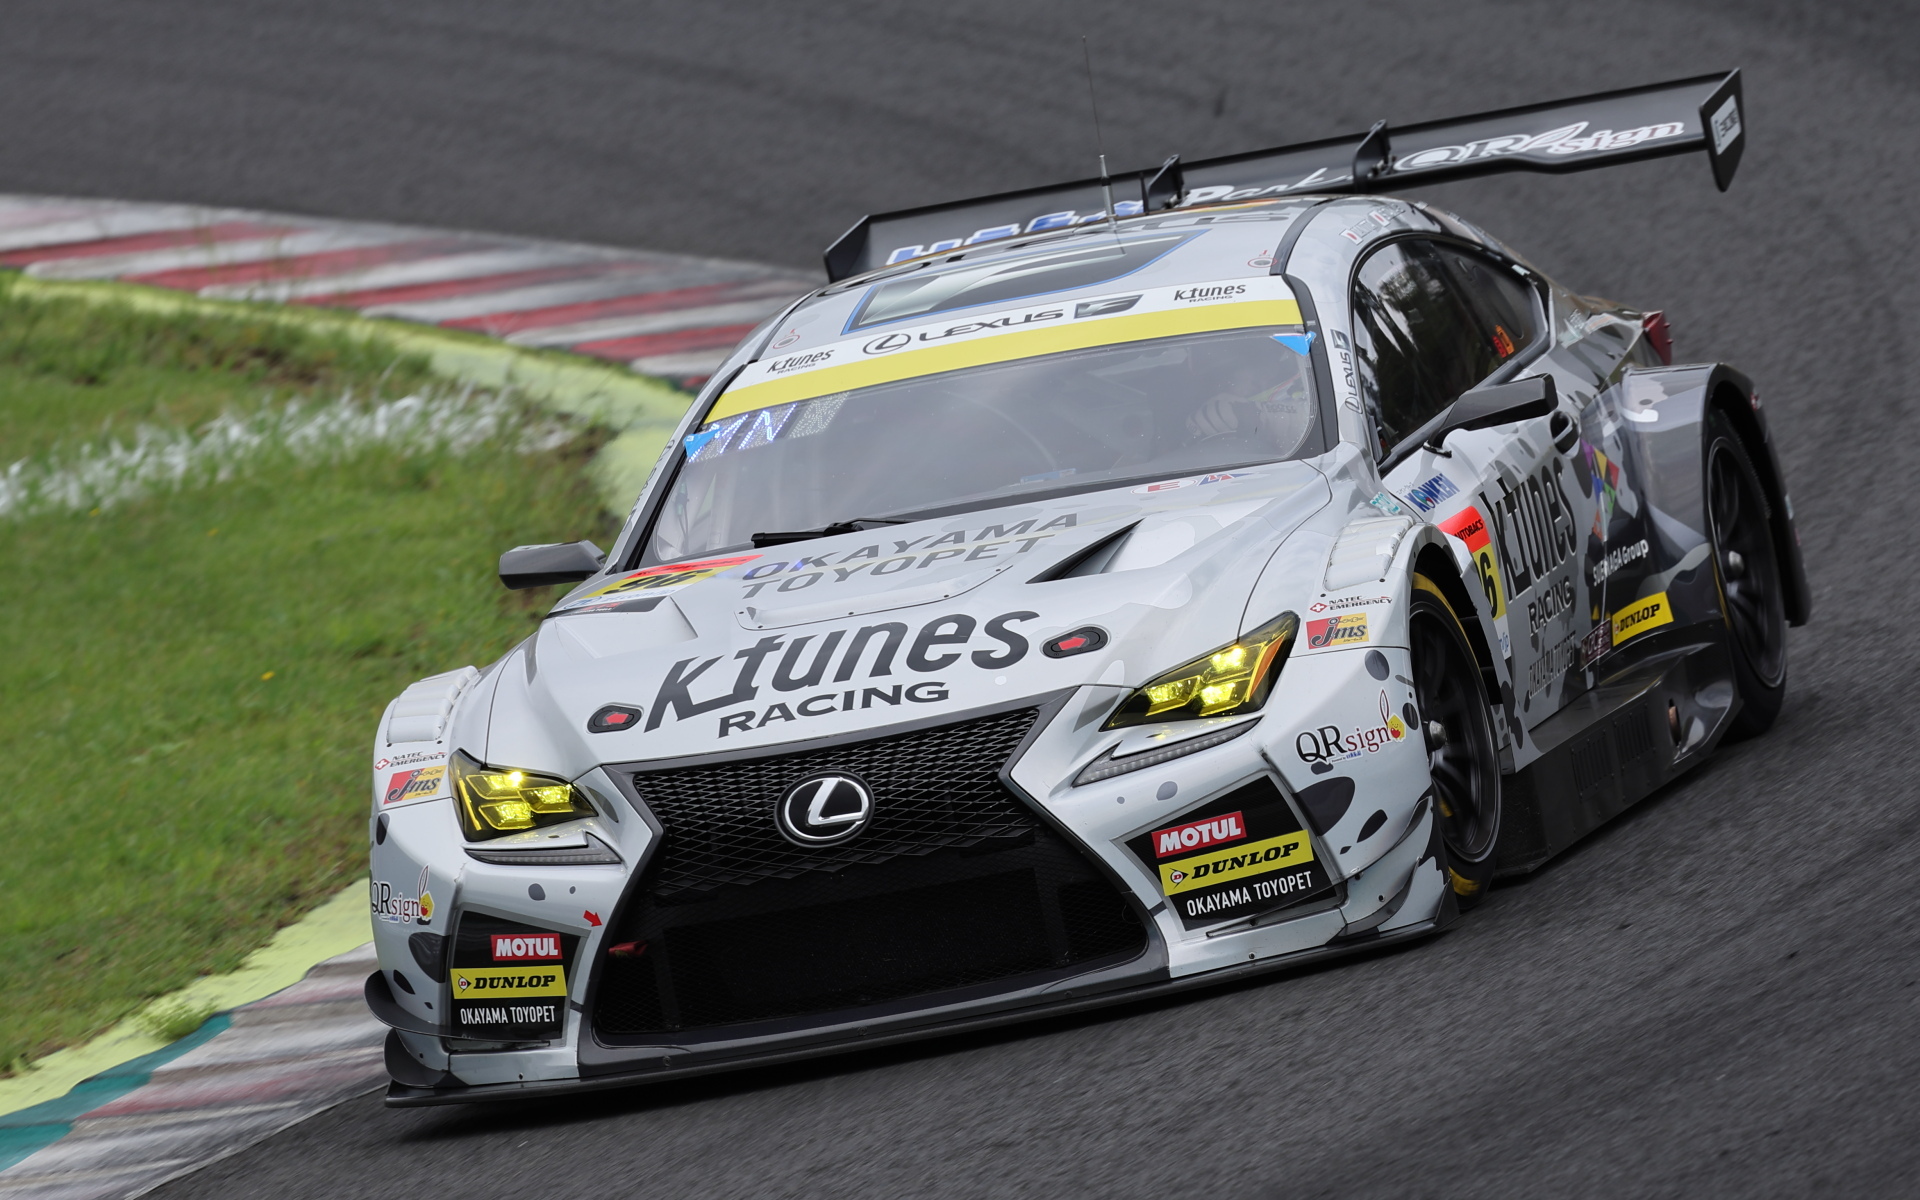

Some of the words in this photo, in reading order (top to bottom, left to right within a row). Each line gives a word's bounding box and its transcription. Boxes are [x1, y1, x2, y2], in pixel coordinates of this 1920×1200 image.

[919, 308, 1064, 343] LEXUS
[1340, 351, 1358, 397] LEXUS
[741, 513, 1078, 580] OKAYAMA
[741, 535, 1055, 599] TOYOPET
[1329, 596, 1362, 604] NATEC
[1329, 598, 1393, 611] EMERGENCY
[1527, 575, 1573, 637] RACING
[1619, 603, 1661, 632] DUNLOP
[717, 681, 950, 738] RACING
[390, 753, 447, 767] EMERGENCY
[392, 751, 423, 760] NATEC
[1159, 816, 1242, 854] MOTUL
[1191, 842, 1300, 880] DUNLOP
[1186, 886, 1252, 917] OKAYAMA
[1253, 871, 1313, 900] TOYOPET
[495, 937, 559, 957] MOTUL
[473, 975, 556, 990] DUNLOP
[460, 1007, 509, 1025] OKAYAMA
[510, 1005, 556, 1023] TOYOPET
